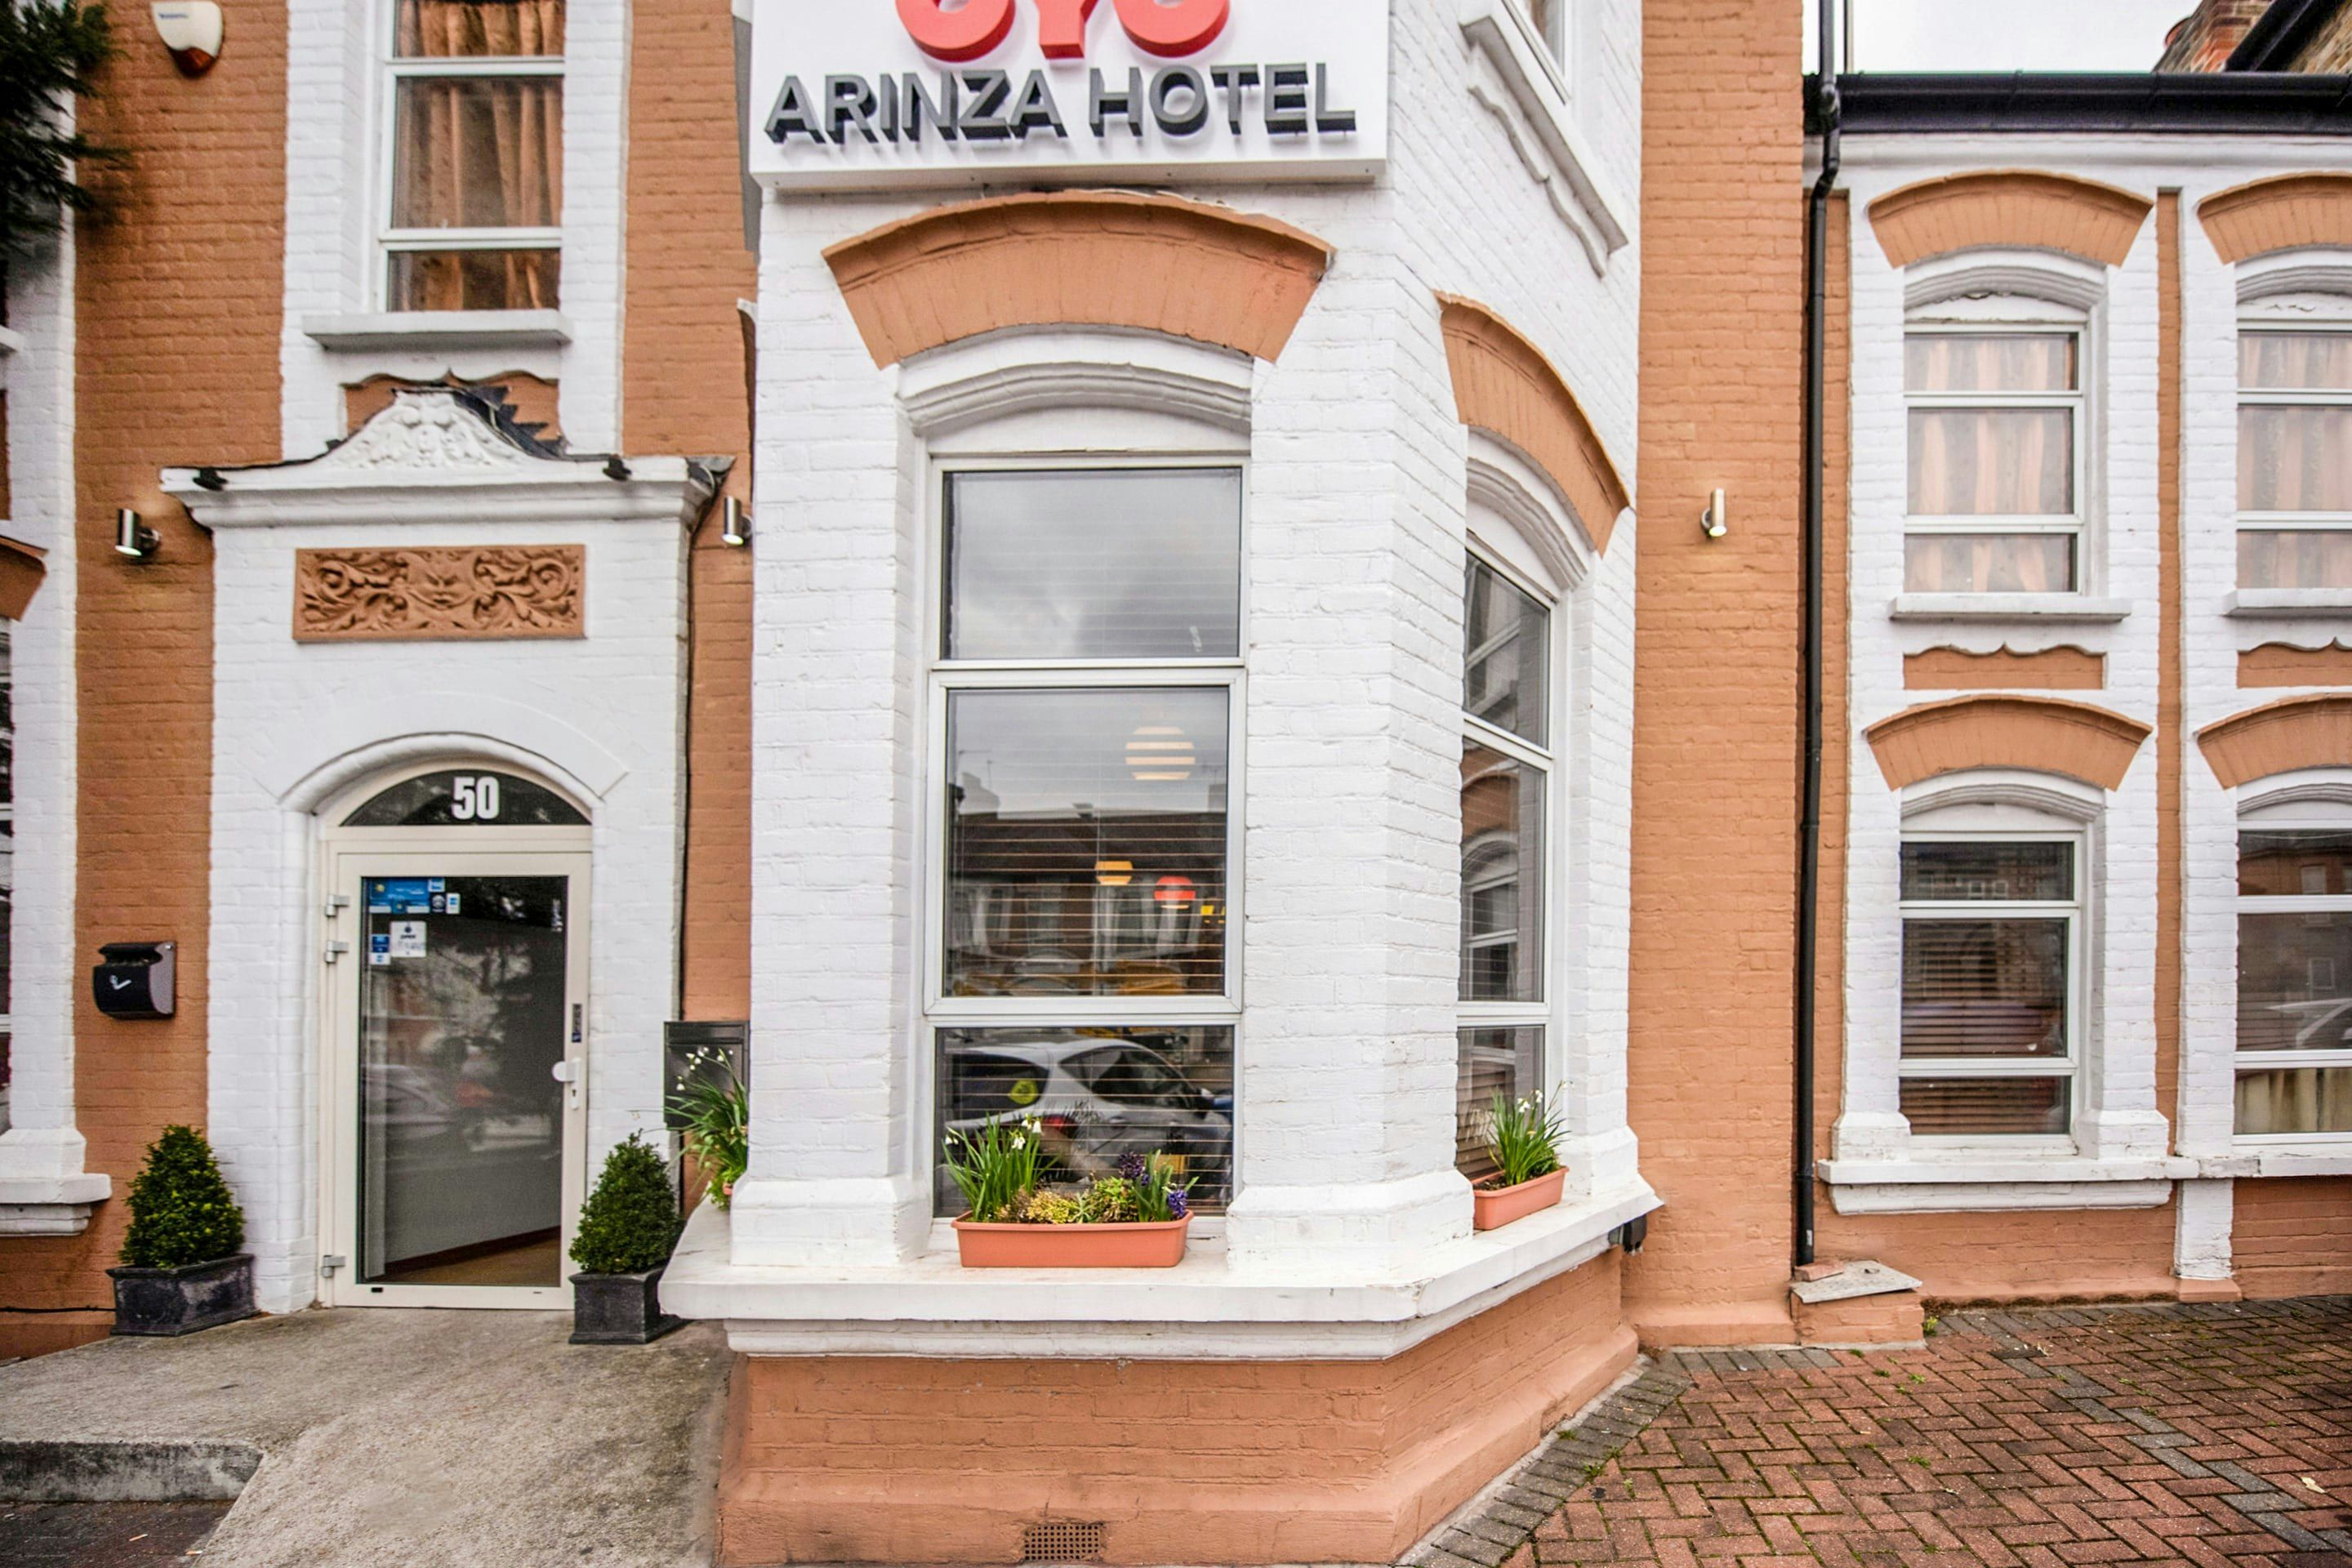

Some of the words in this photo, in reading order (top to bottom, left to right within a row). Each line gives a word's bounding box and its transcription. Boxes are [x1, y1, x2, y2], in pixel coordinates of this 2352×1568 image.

[764, 68, 1069, 145] ARINZA
[1089, 62, 1356, 137] HOTEL
[451, 776, 500, 820] 50
